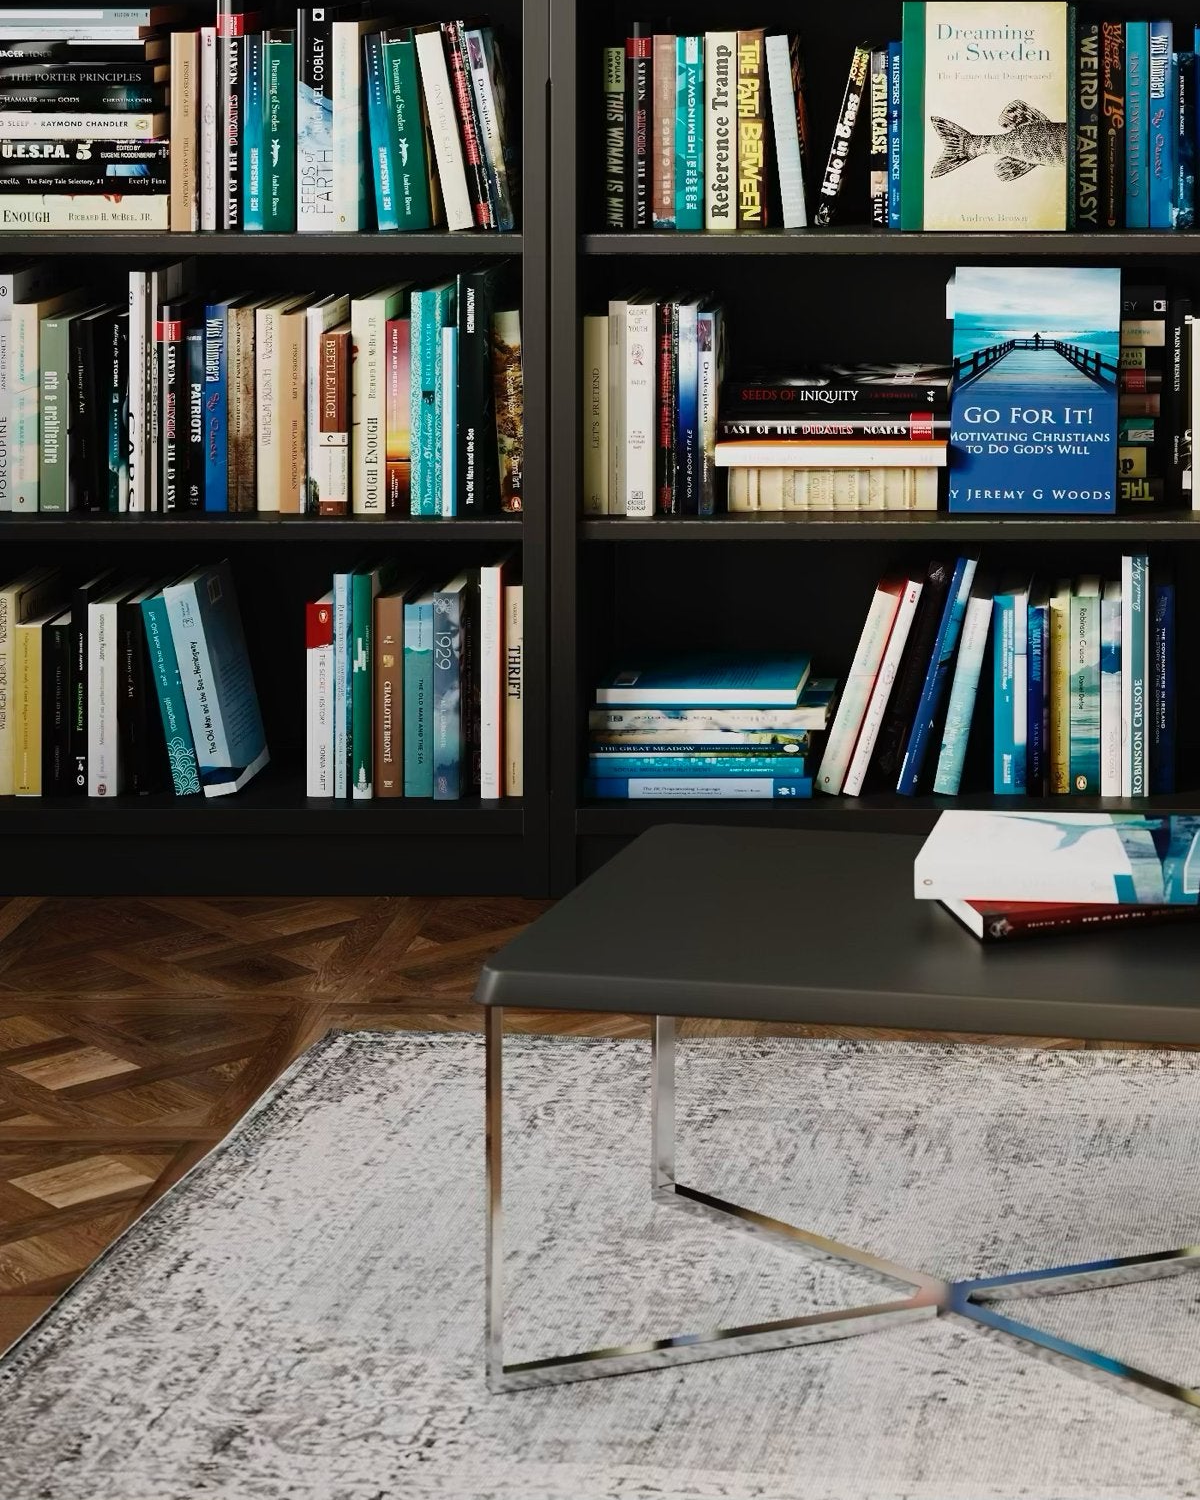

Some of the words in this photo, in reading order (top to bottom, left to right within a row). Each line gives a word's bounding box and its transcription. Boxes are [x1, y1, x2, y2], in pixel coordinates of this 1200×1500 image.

[936, 23, 1035, 45] Dreaming
[966, 43, 1051, 62] Sweden
[1109, 22, 1122, 70] Where
[313, 37, 324, 81] COBLEY
[737, 40, 760, 75] THE
[1080, 35, 1098, 110] WEIRD
[1103, 21, 1112, 91] Shadows
[269, 59, 280, 95] Dreaming
[392, 59, 404, 94] Dreaming
[712, 45, 731, 111] Tramp
[313, 84, 324, 133] MICHAEL
[396, 103, 406, 131] Sweden
[606, 93, 624, 121] THIS
[688, 67, 696, 153] HEMINGWAY
[737, 78, 760, 118] PATH
[871, 73, 888, 155] STAIRCASE
[271, 104, 280, 132] Sweden
[76, 143, 92, 160] 5
[606, 127, 624, 174] WOMAN
[662, 118, 671, 166] GANGS
[379, 147, 391, 194] MASSACRE
[606, 180, 624, 192] IS
[712, 116, 730, 218] Reference
[739, 122, 763, 221] BETWEEN
[1079, 125, 1098, 224] FANTASY
[383, 197, 392, 211] ICE
[662, 172, 671, 205] GIRL
[3, 210, 50, 223] ENOUGH
[606, 198, 624, 228] MINE
[325, 339, 336, 418] BEETLEJUICE
[591, 367, 600, 416] PRETEND
[741, 391, 777, 400] SEEDS
[780, 391, 797, 400] OF
[800, 390, 859, 404] INIQUITY
[190, 383, 201, 443] PATRIOTS
[364, 417, 378, 465] ENOUGH
[591, 421, 600, 449] LET'S
[966, 445, 984, 455] TO
[987, 445, 1007, 455] DO
[1013, 444, 1054, 455] GOD'S
[1057, 445, 1090, 455] WILL
[1032, 432, 1110, 443] CHRISTIANS
[364, 469, 378, 509] ROUGH
[967, 489, 1024, 501] JEREMY
[1032, 489, 1043, 500] G
[1052, 489, 1111, 500] WOODS
[435, 631, 452, 670] 1929
[1031, 629, 1041, 682] WALKAWAY
[507, 645, 522, 699] THRIFT
[198, 692, 207, 702] the
[200, 703, 208, 714] and
[1133, 679, 1143, 727] CRUSOE
[203, 715, 212, 728] Man
[206, 729, 215, 741] Old
[208, 741, 217, 754] The
[1133, 731, 1143, 794] ROBINSON
